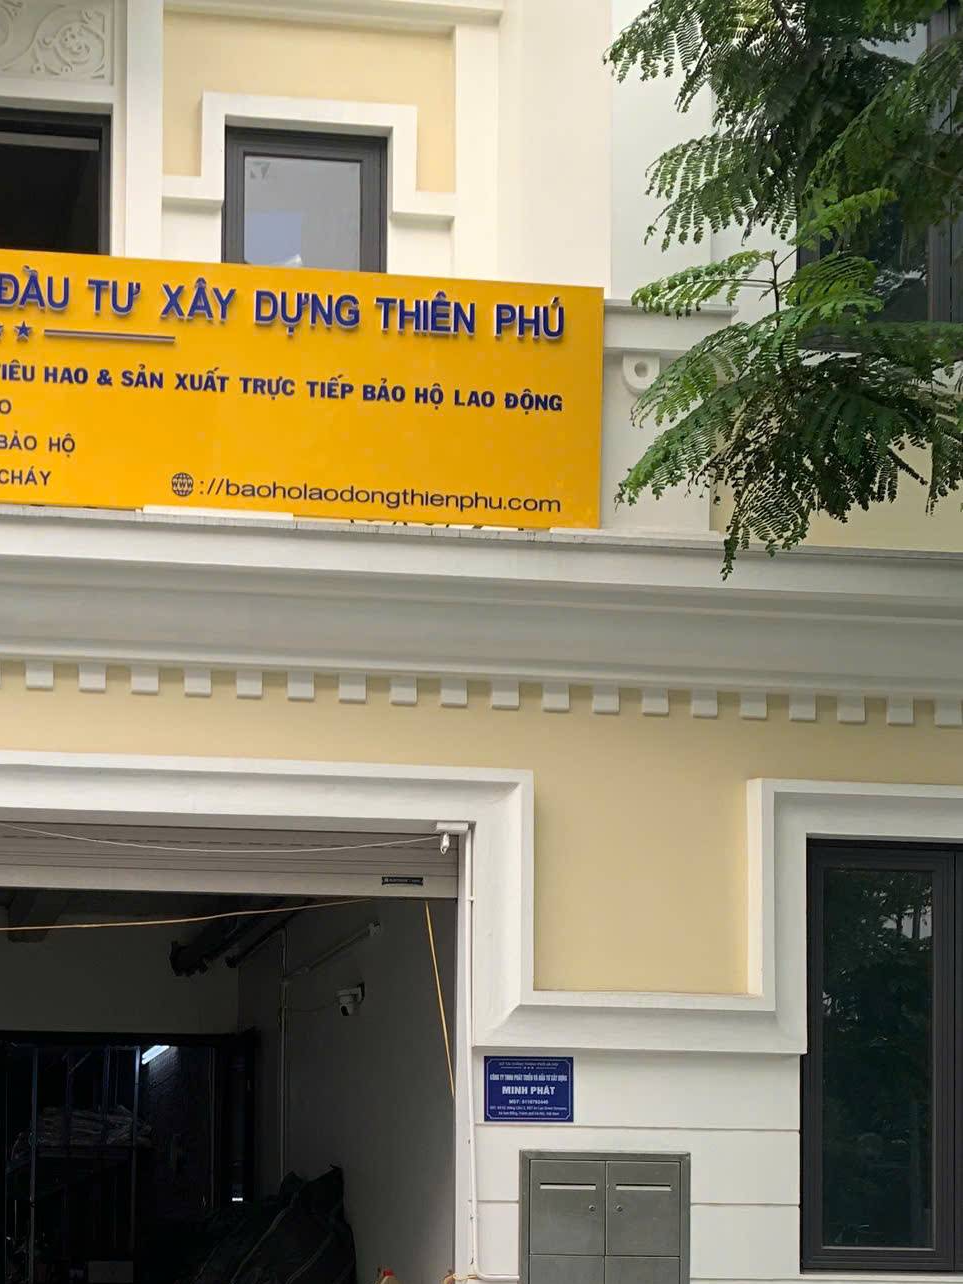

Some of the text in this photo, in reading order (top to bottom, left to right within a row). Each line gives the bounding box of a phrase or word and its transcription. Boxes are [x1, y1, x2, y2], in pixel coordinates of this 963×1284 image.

[87, 279, 141, 316] TƯ
[160, 277, 236, 322] XÂY
[254, 289, 360, 335] DỰNG
[374, 290, 475, 336] THIÊN
[494, 296, 565, 339] PHÚ
[44, 366, 88, 384] HAO
[96, 368, 113, 386] &
[121, 363, 164, 389] SẢN
[175, 367, 229, 393] XUẤT
[239, 376, 295, 400] TRỰC
[306, 374, 354, 399] TIẾP
[362, 378, 406, 403] BẢO
[414, 382, 444, 410] HỘ
[454, 389, 495, 408] LAO
[504, 388, 563, 415] ĐỘNG
[49, 433, 76, 458] HỘ
[502, 1086, 527, 1095] MINH
